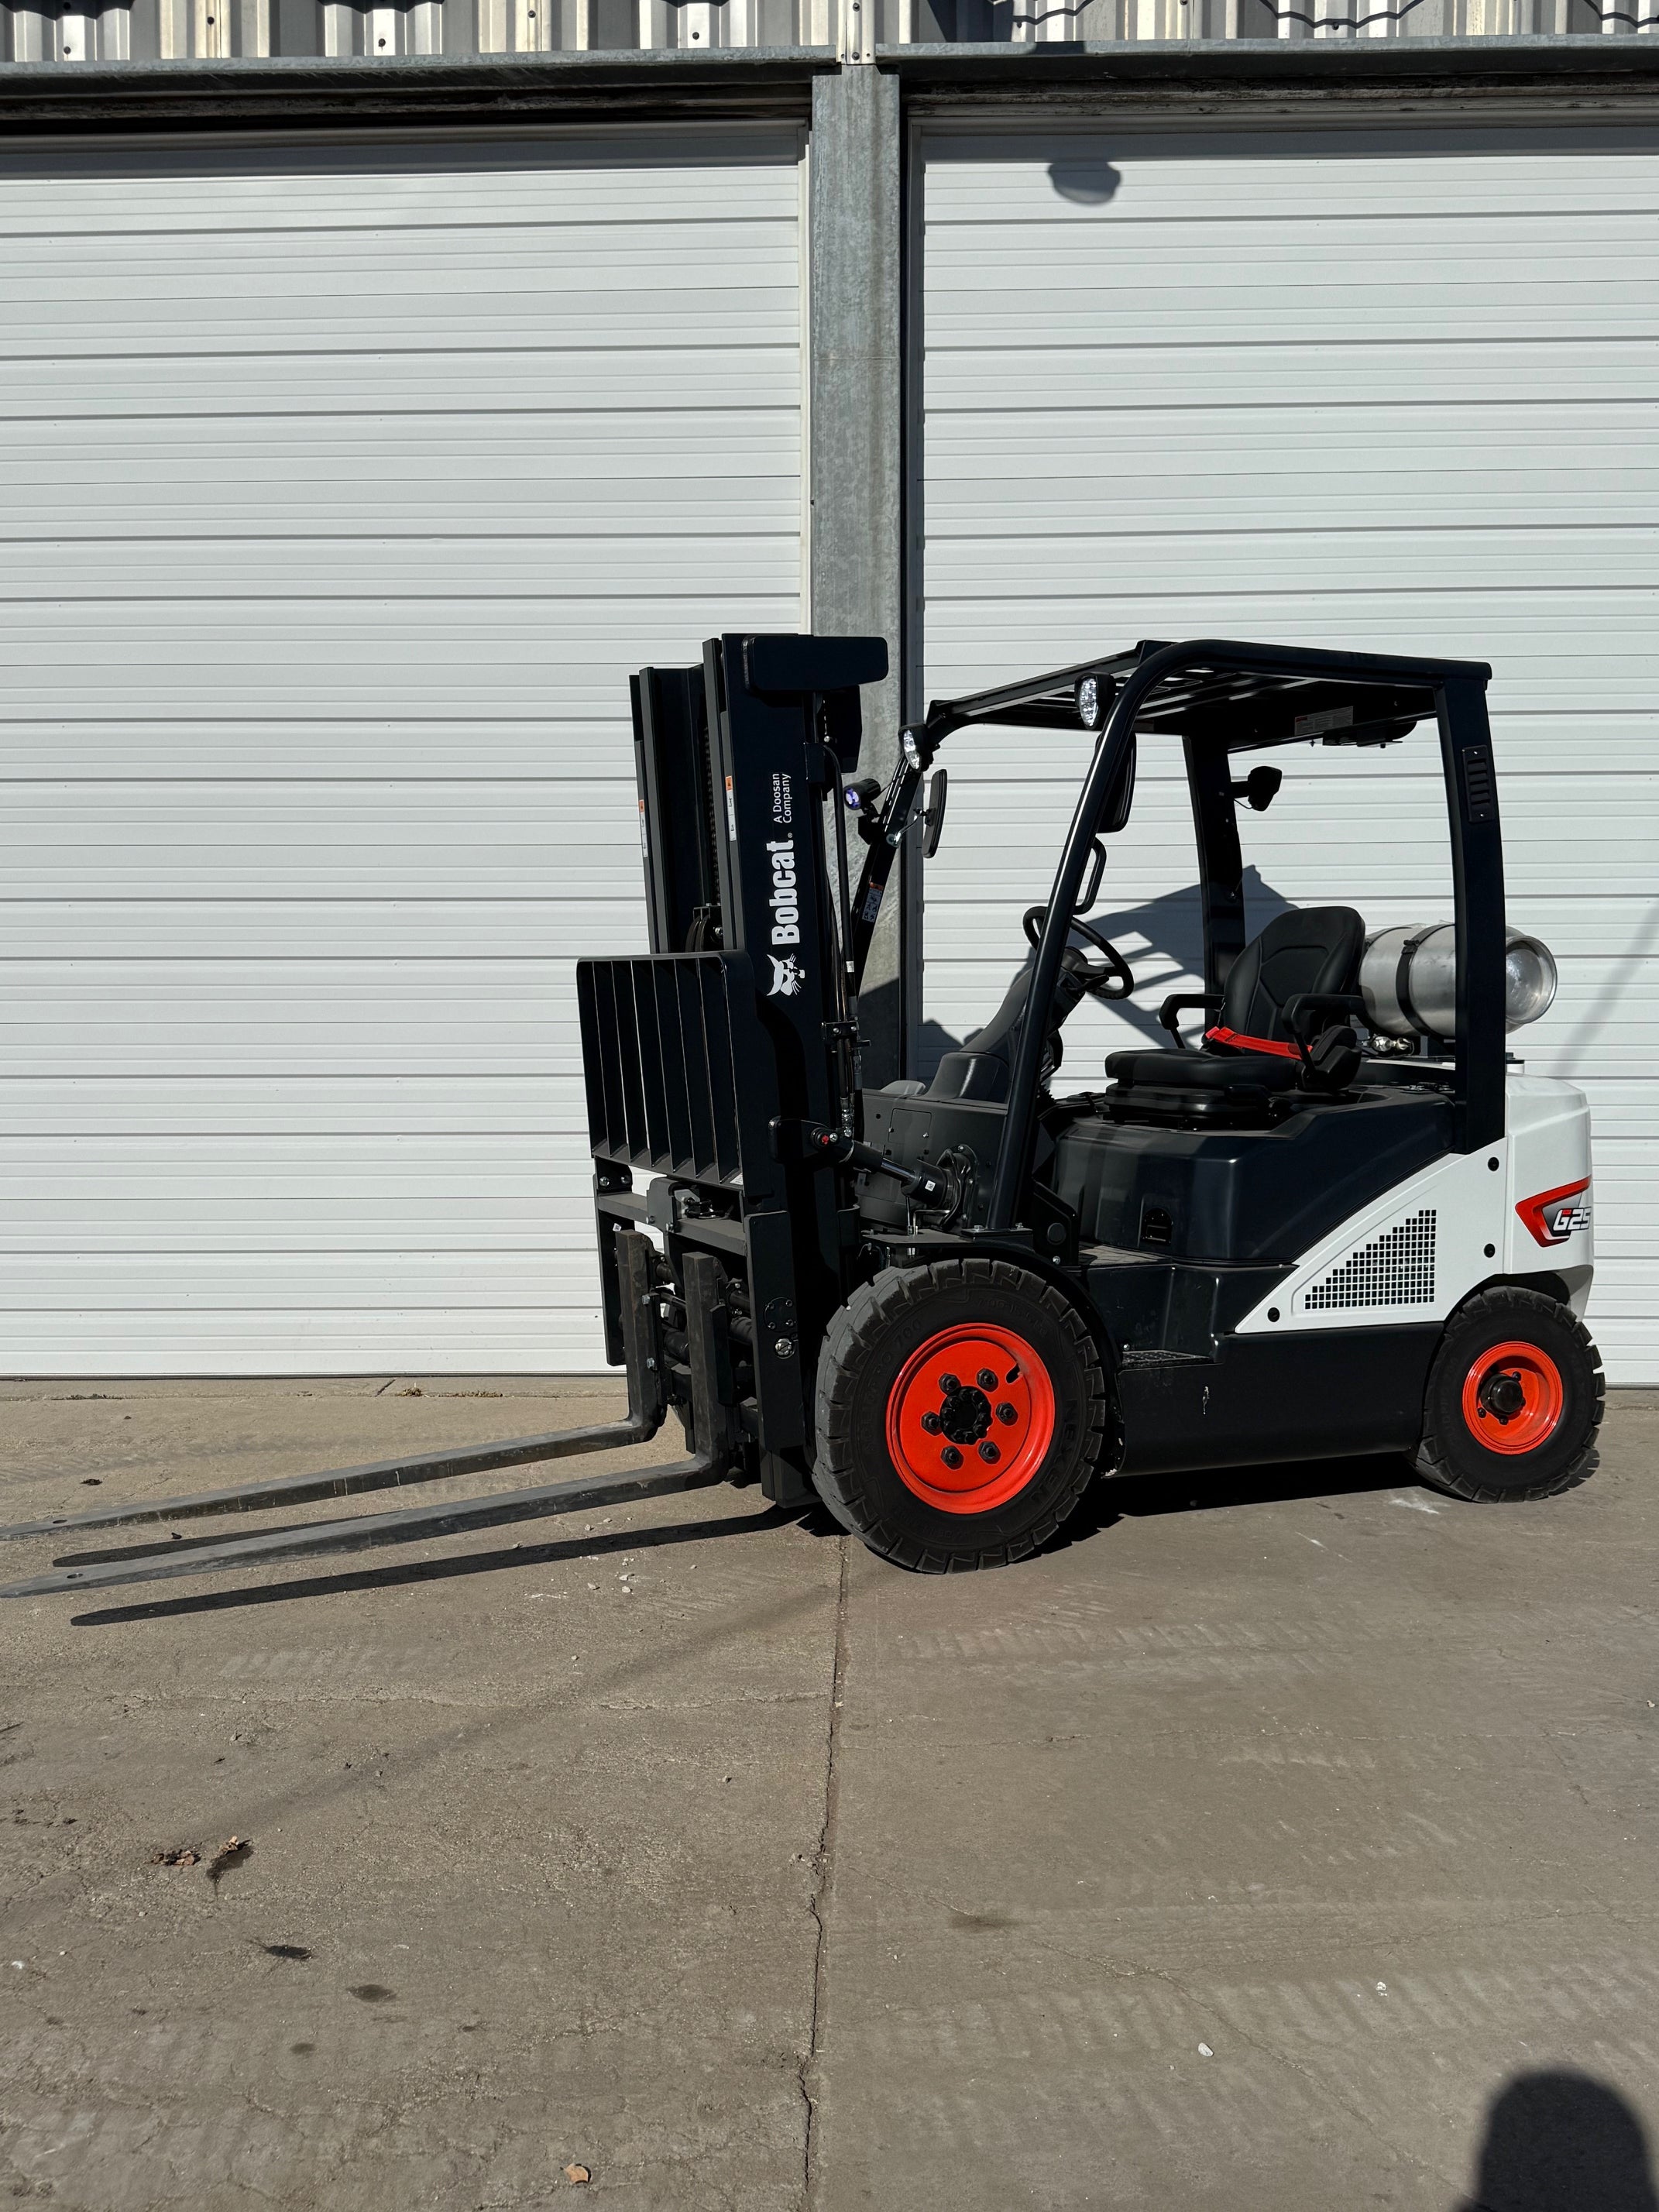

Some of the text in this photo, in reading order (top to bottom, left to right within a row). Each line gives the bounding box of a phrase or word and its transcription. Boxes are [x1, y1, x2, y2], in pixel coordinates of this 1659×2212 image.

[772, 773, 783, 823] A Doosan
[781, 773, 793, 823] Company
[766, 840, 800, 945] Bobcat
